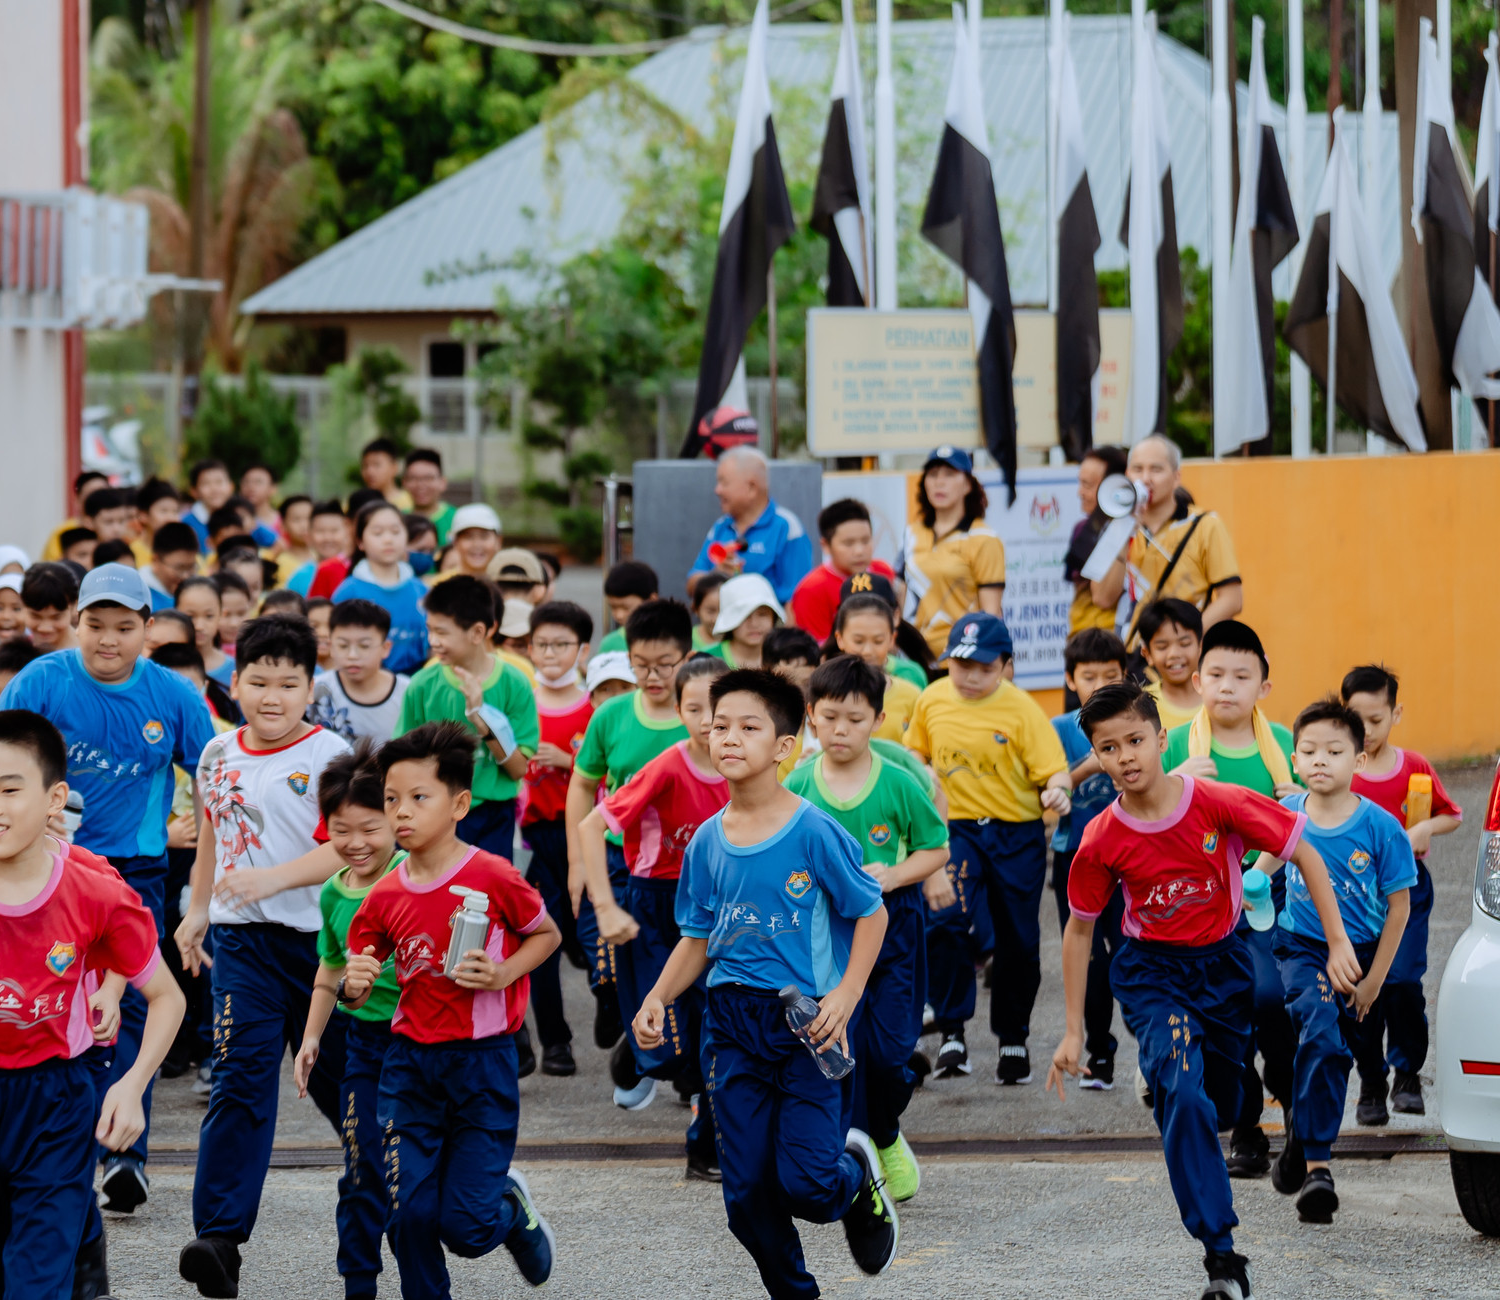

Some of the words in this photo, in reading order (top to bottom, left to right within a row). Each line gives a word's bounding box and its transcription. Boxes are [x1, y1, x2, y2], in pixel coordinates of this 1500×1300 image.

[885, 327, 969, 348] PERHATIAN
[1018, 605, 1050, 622] JENIS
[1038, 624, 1068, 639] KONG
[668, 1008, 678, 1034] KONG
[672, 1035, 682, 1056] MIN
